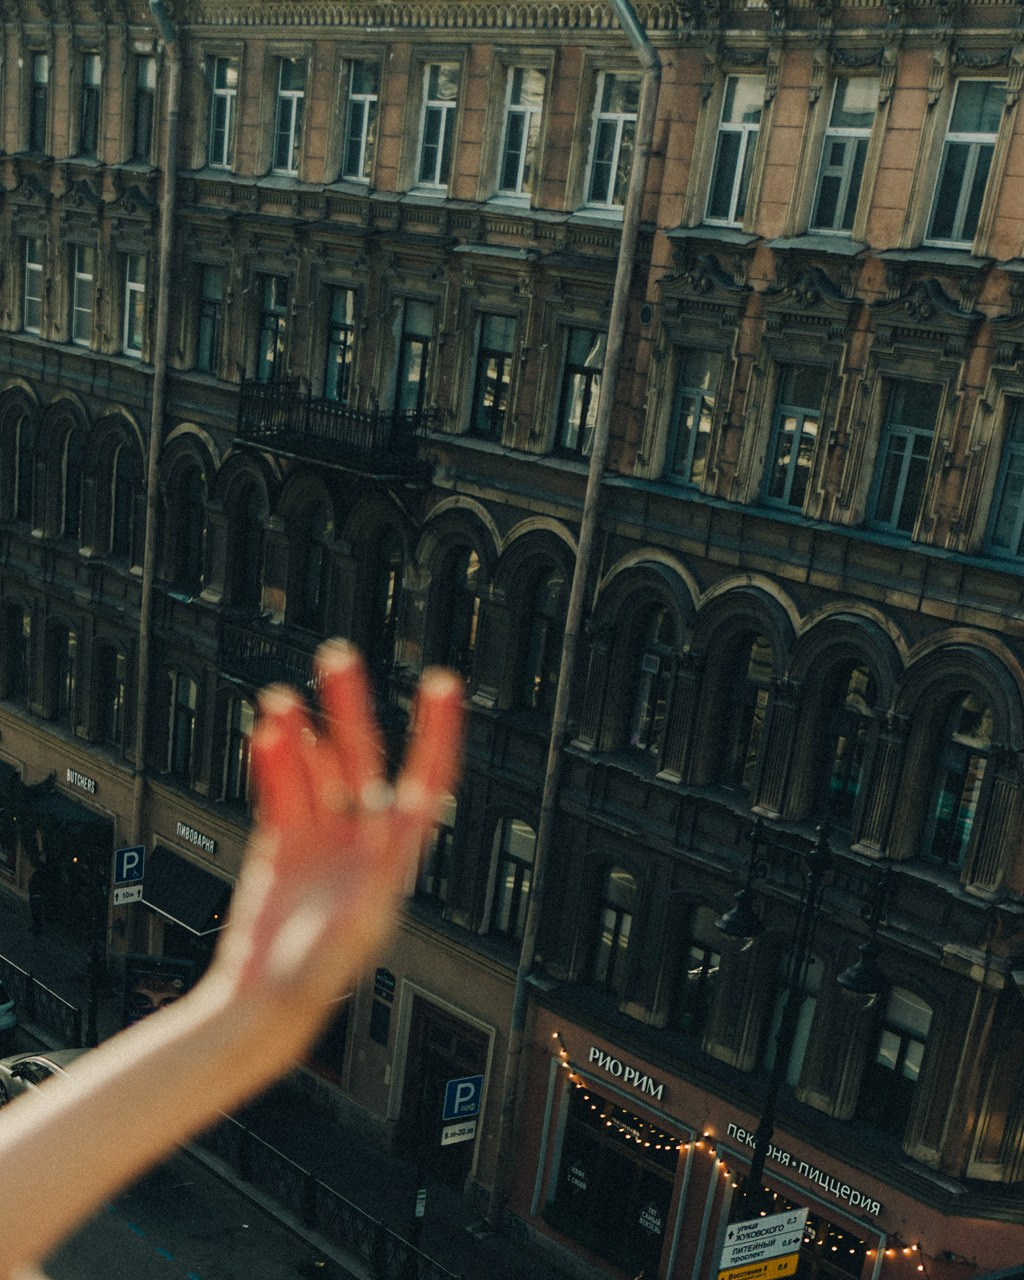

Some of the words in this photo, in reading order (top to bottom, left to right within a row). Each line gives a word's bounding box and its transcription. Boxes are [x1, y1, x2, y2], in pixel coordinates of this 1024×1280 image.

[66, 768, 95, 794] BUTCHERS
[176, 821, 215, 854] ПИВОВАРНЯ
[122, 851, 139, 879] P
[588, 1046, 624, 1077] РИО
[623, 1065, 666, 1101] РИМ
[453, 1082, 476, 1114] P
[726, 1122, 791, 1167] пекня
[798, 1160, 881, 1217] пиццерия
[735, 1224, 784, 1241] ЖУКОВСКОГО
[737, 1222, 758, 1234] улица
[730, 1250, 764, 1264] проспект
[731, 1239, 776, 1256] ЛИТЕЙНЫЙ
